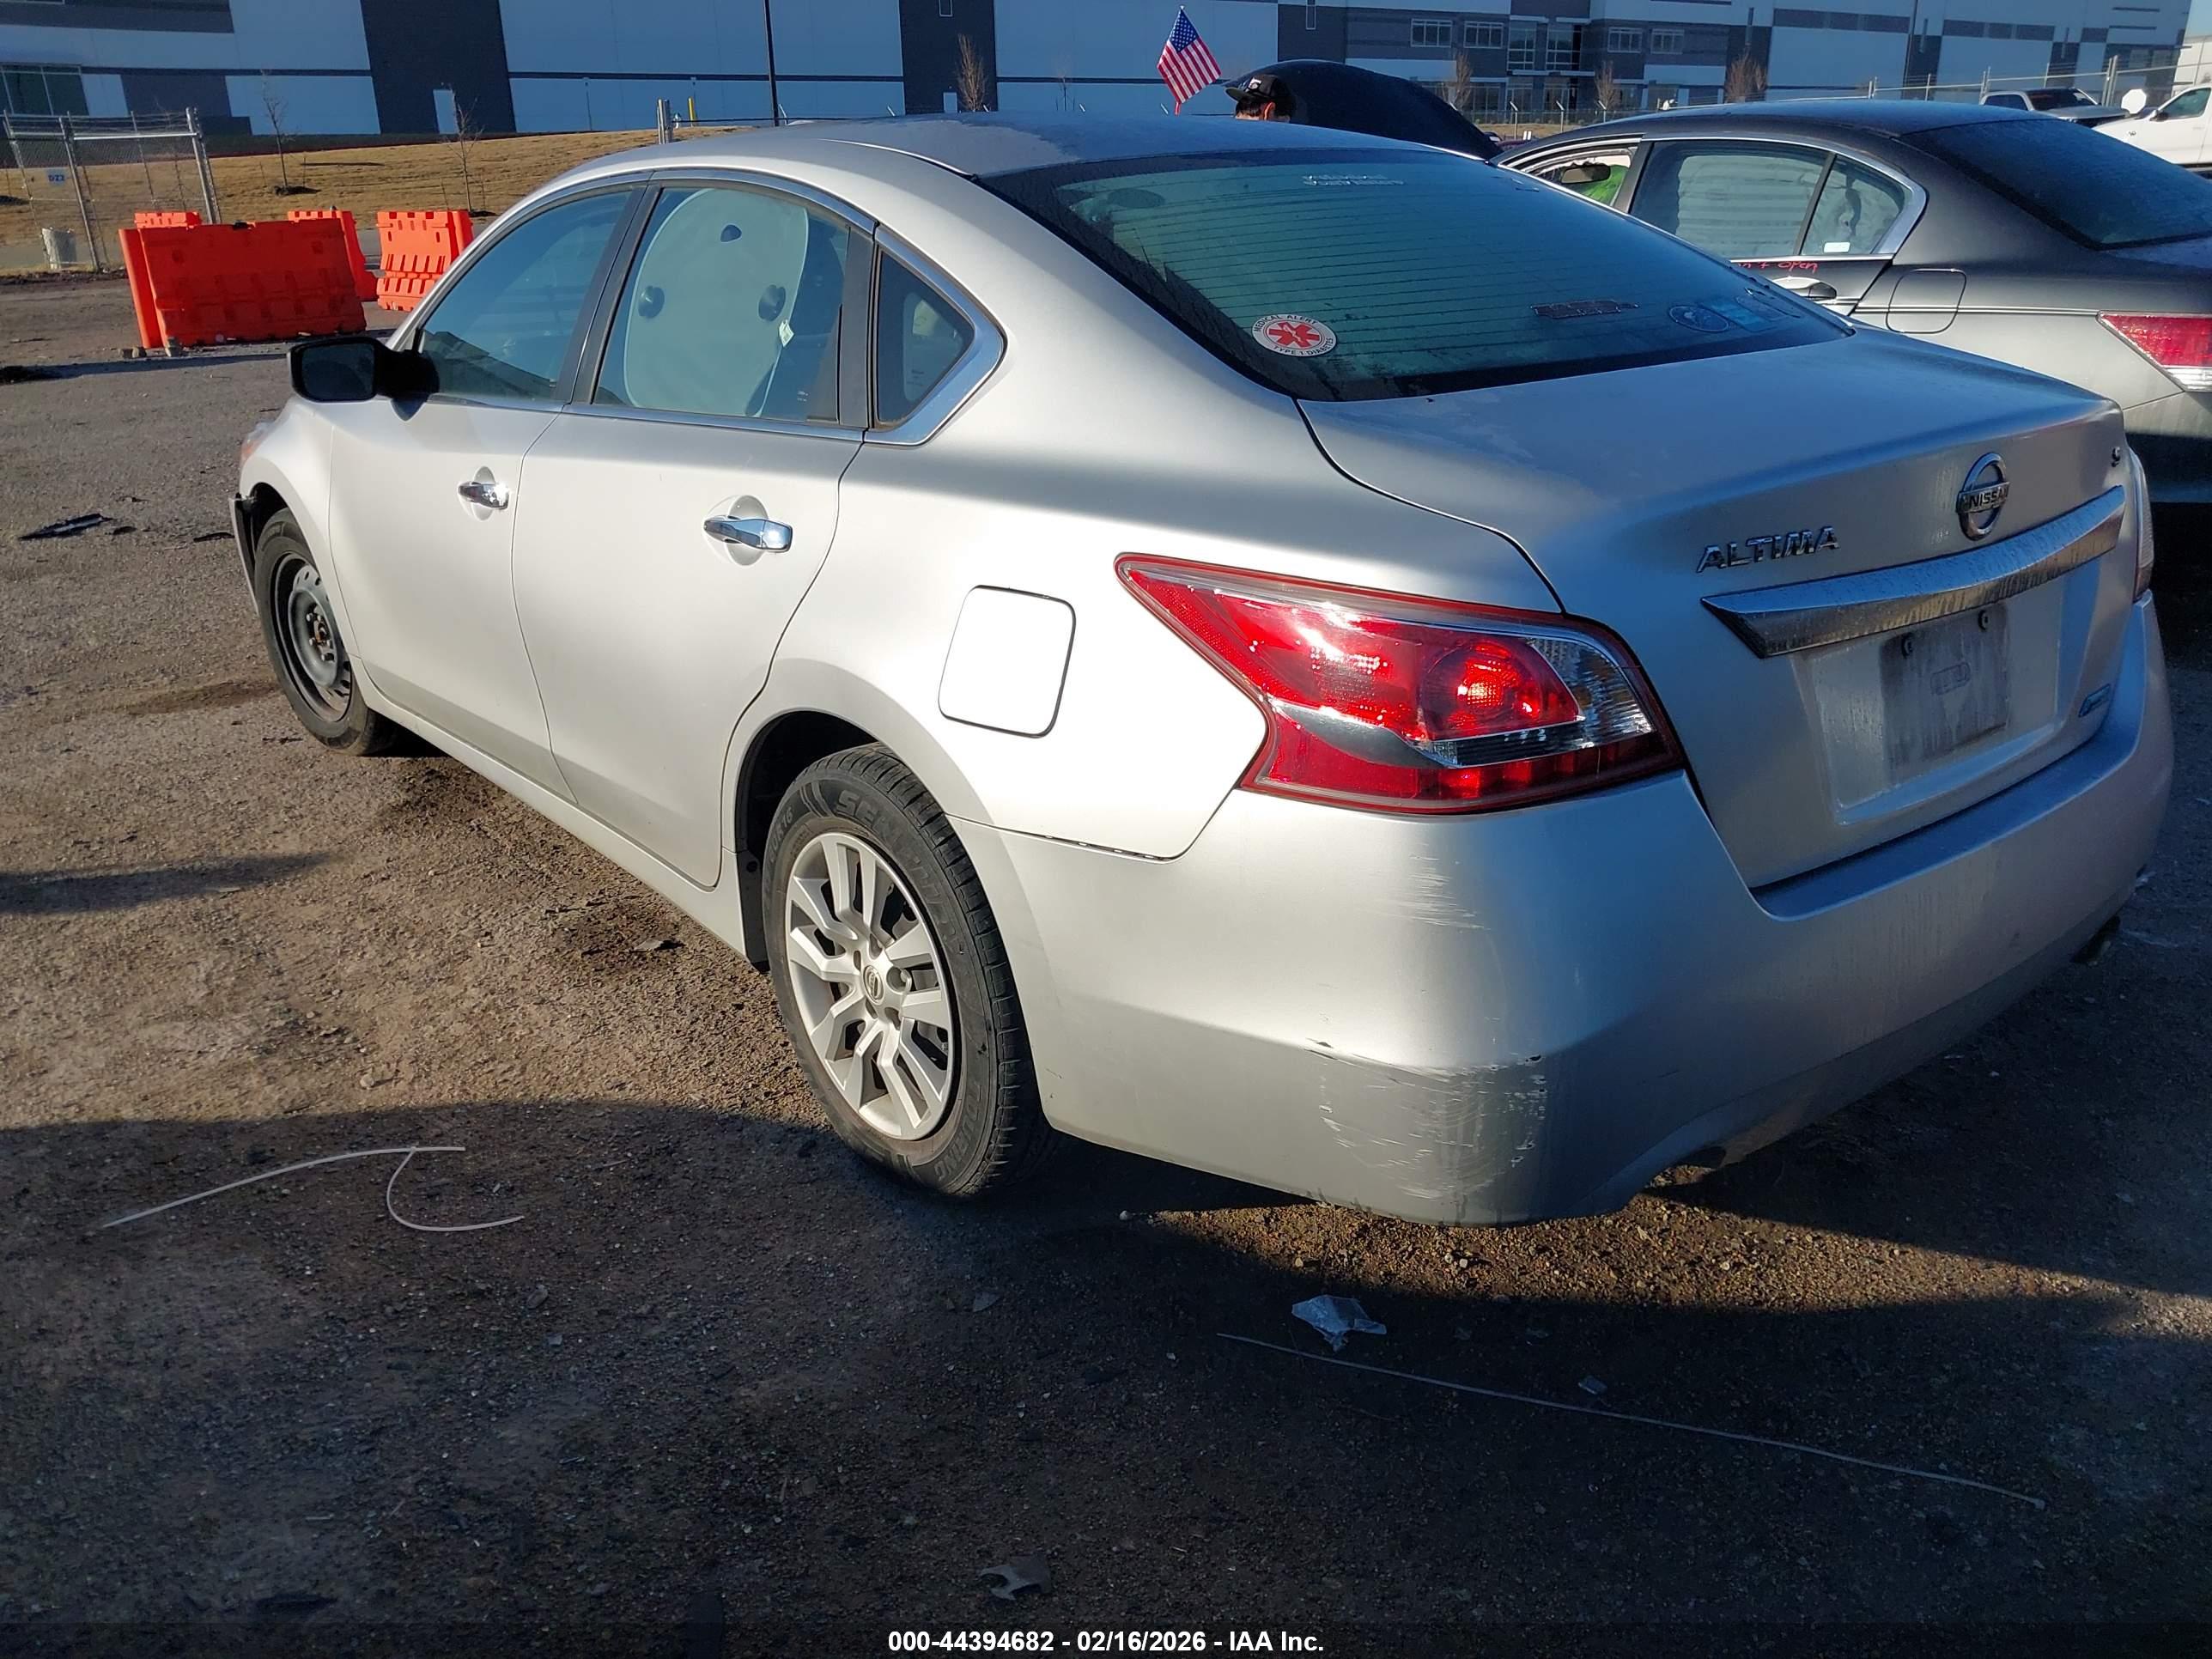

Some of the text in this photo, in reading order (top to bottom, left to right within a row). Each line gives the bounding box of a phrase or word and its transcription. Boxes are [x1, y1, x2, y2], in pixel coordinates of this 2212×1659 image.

[1254, 314, 1317, 331] MEDICAL ALERT
[1273, 345, 1297, 356] TYPE
[1306, 337, 1334, 356] DIABETES
[1969, 485, 2008, 507] NISSAN
[1696, 526, 1840, 574] ALTIMA
